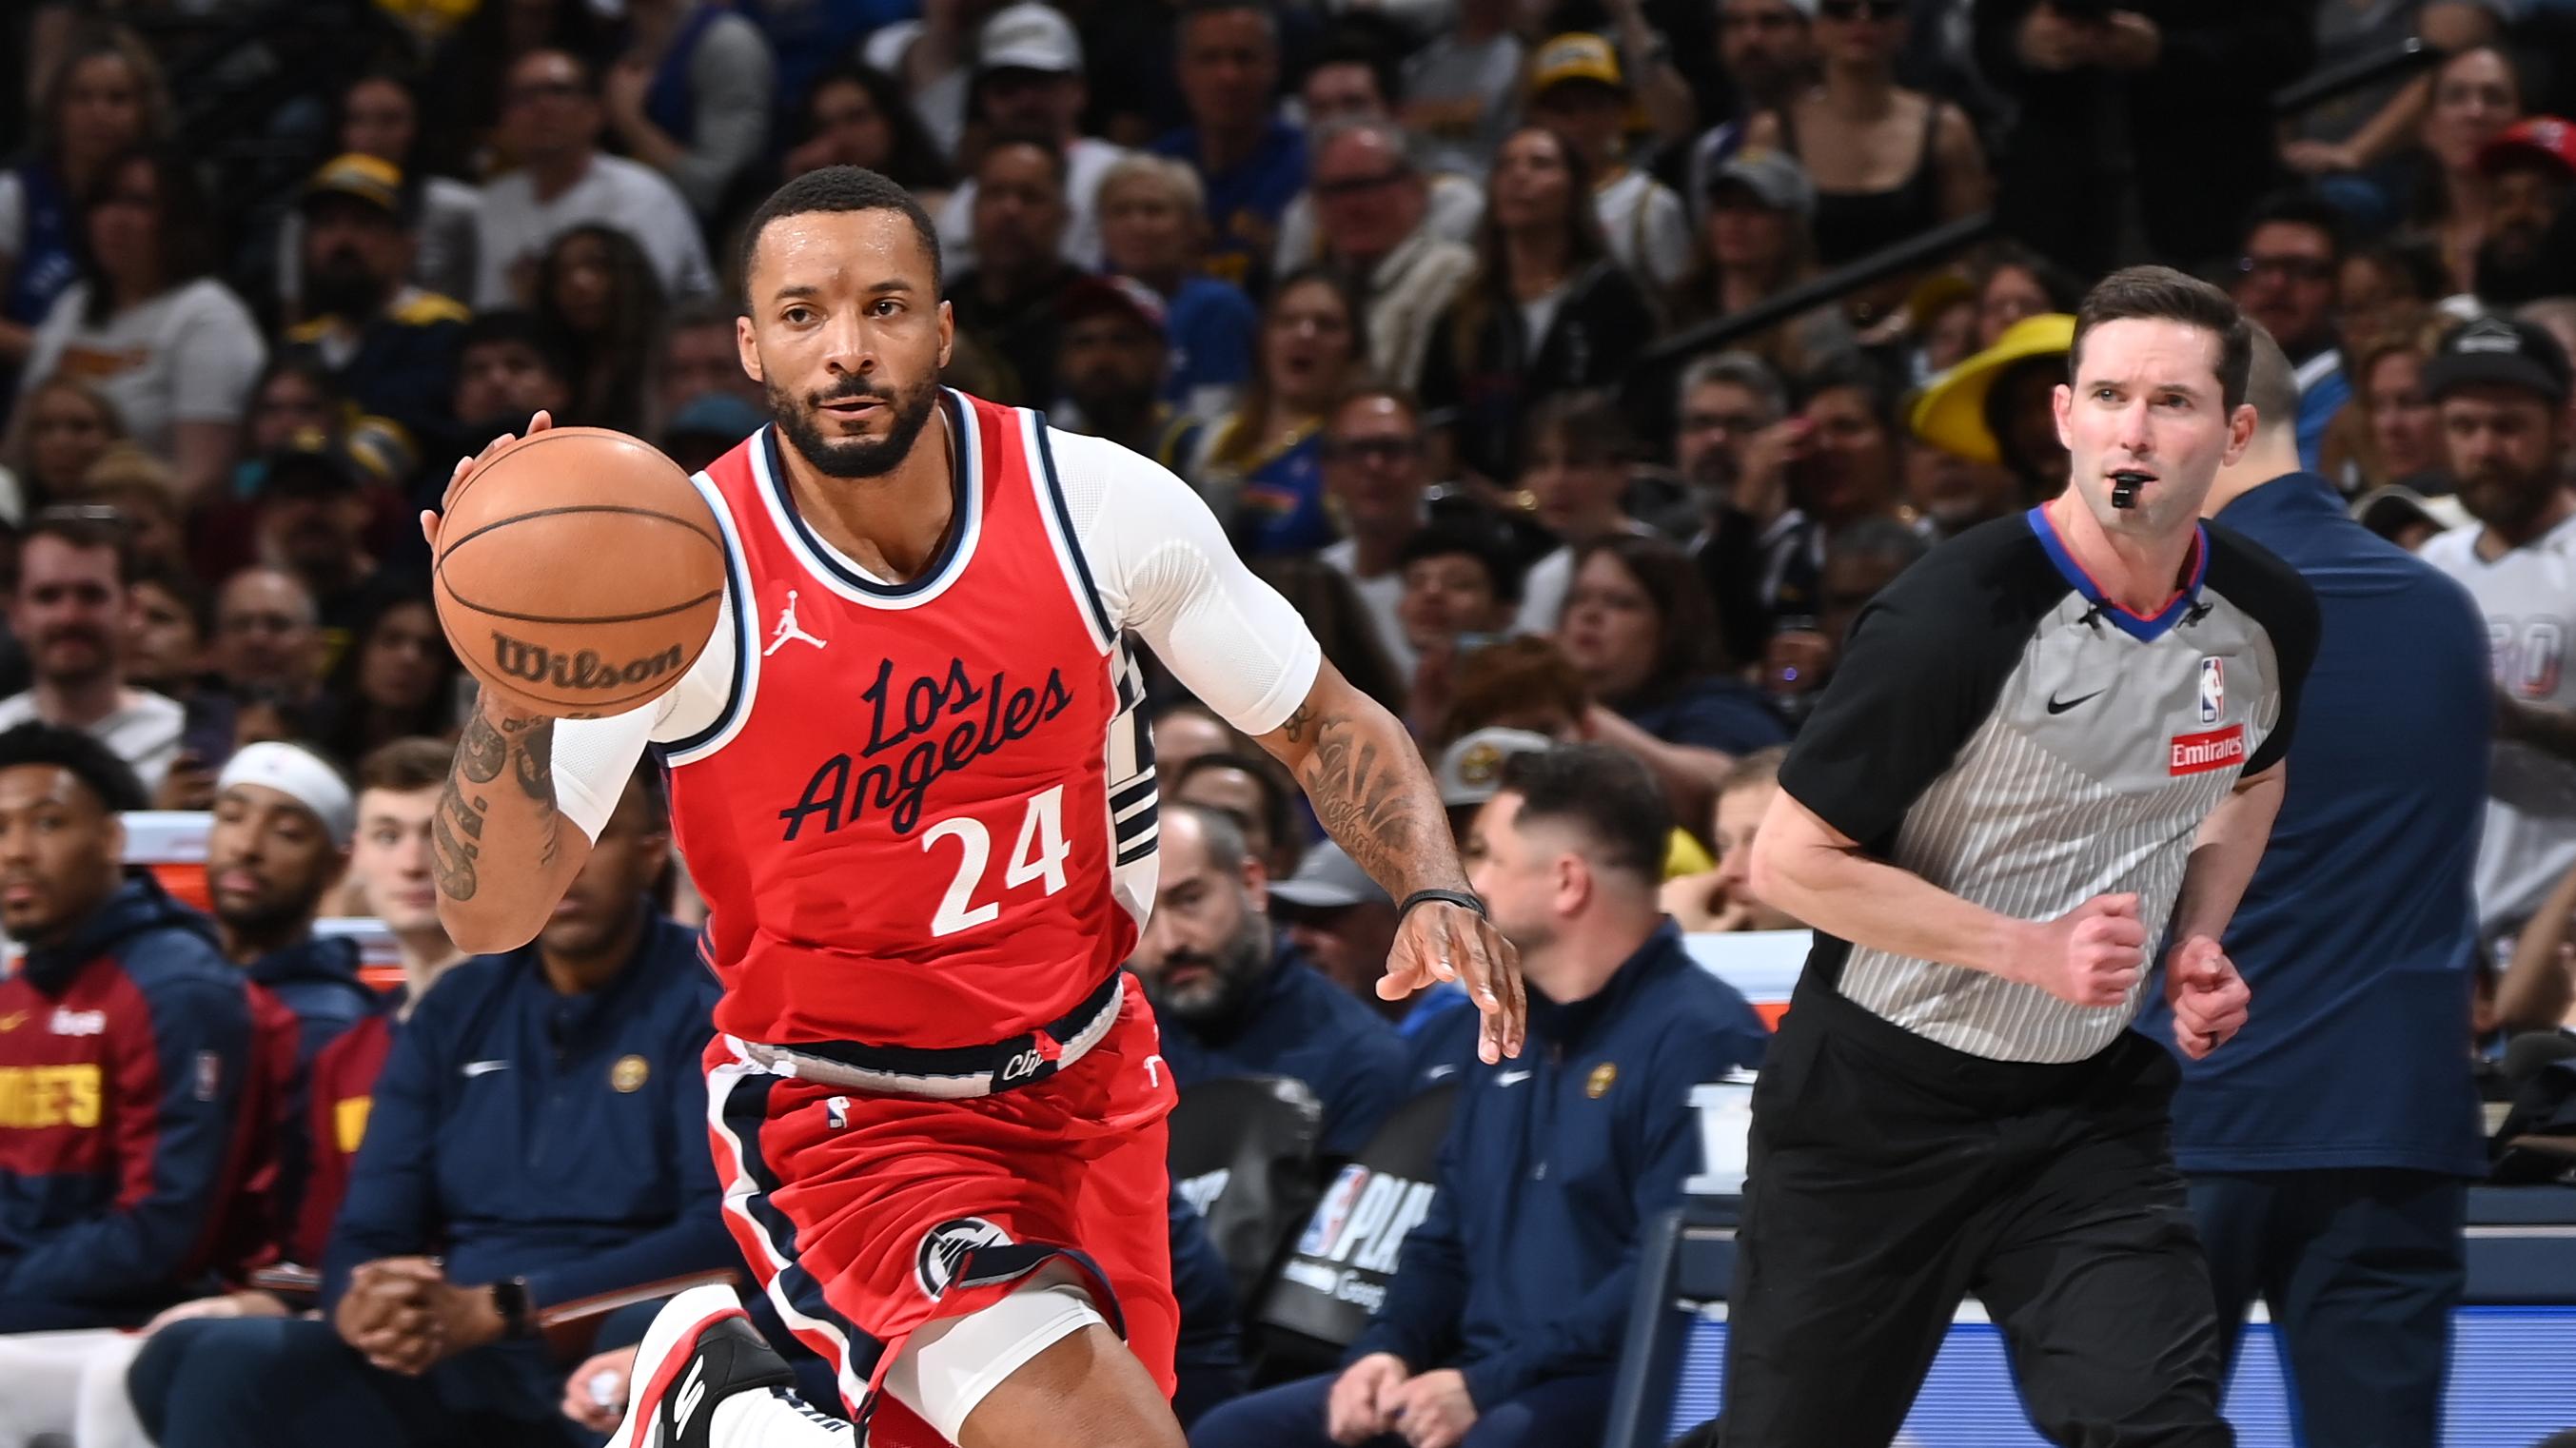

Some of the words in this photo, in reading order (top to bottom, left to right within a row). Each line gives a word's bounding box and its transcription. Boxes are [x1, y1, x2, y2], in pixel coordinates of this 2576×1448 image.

[491, 630, 682, 690] Wilson
[860, 657, 984, 758] Los
[778, 668, 1073, 841] Angeles
[2173, 736, 2242, 767] Emirates
[921, 784, 1072, 938] 24
